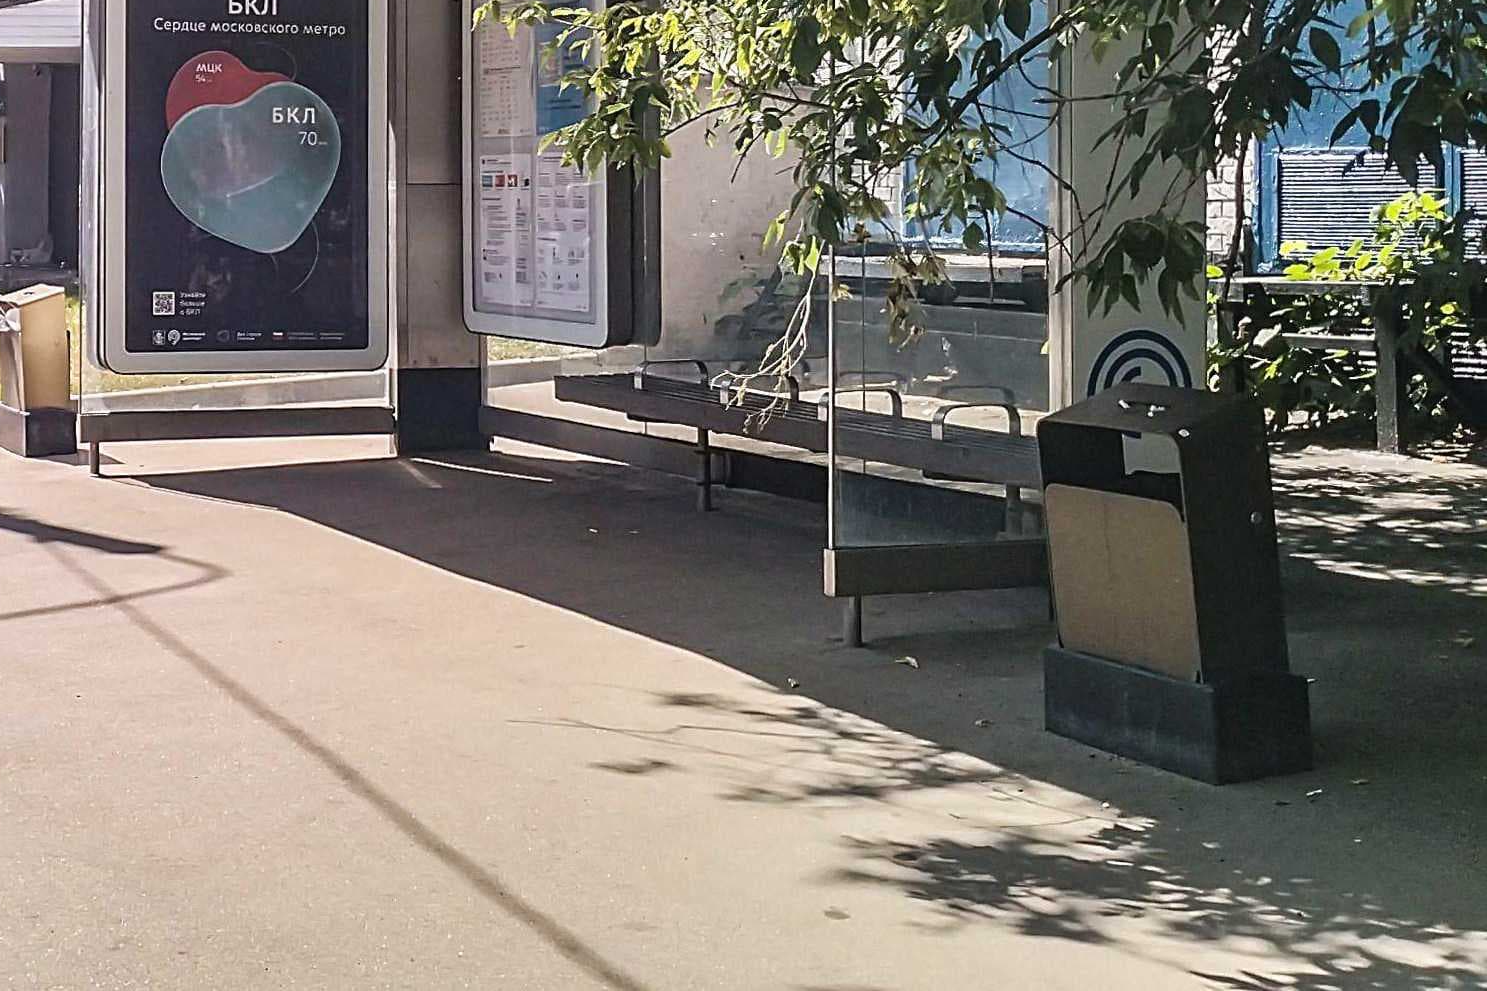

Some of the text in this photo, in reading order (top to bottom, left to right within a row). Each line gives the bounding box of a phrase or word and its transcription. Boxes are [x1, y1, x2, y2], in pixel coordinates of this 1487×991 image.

[154, 18, 346, 37] Сердце московского метро
[196, 63, 223, 74] МЦК
[272, 107, 316, 125] БКЛ
[299, 132, 318, 147] 70
